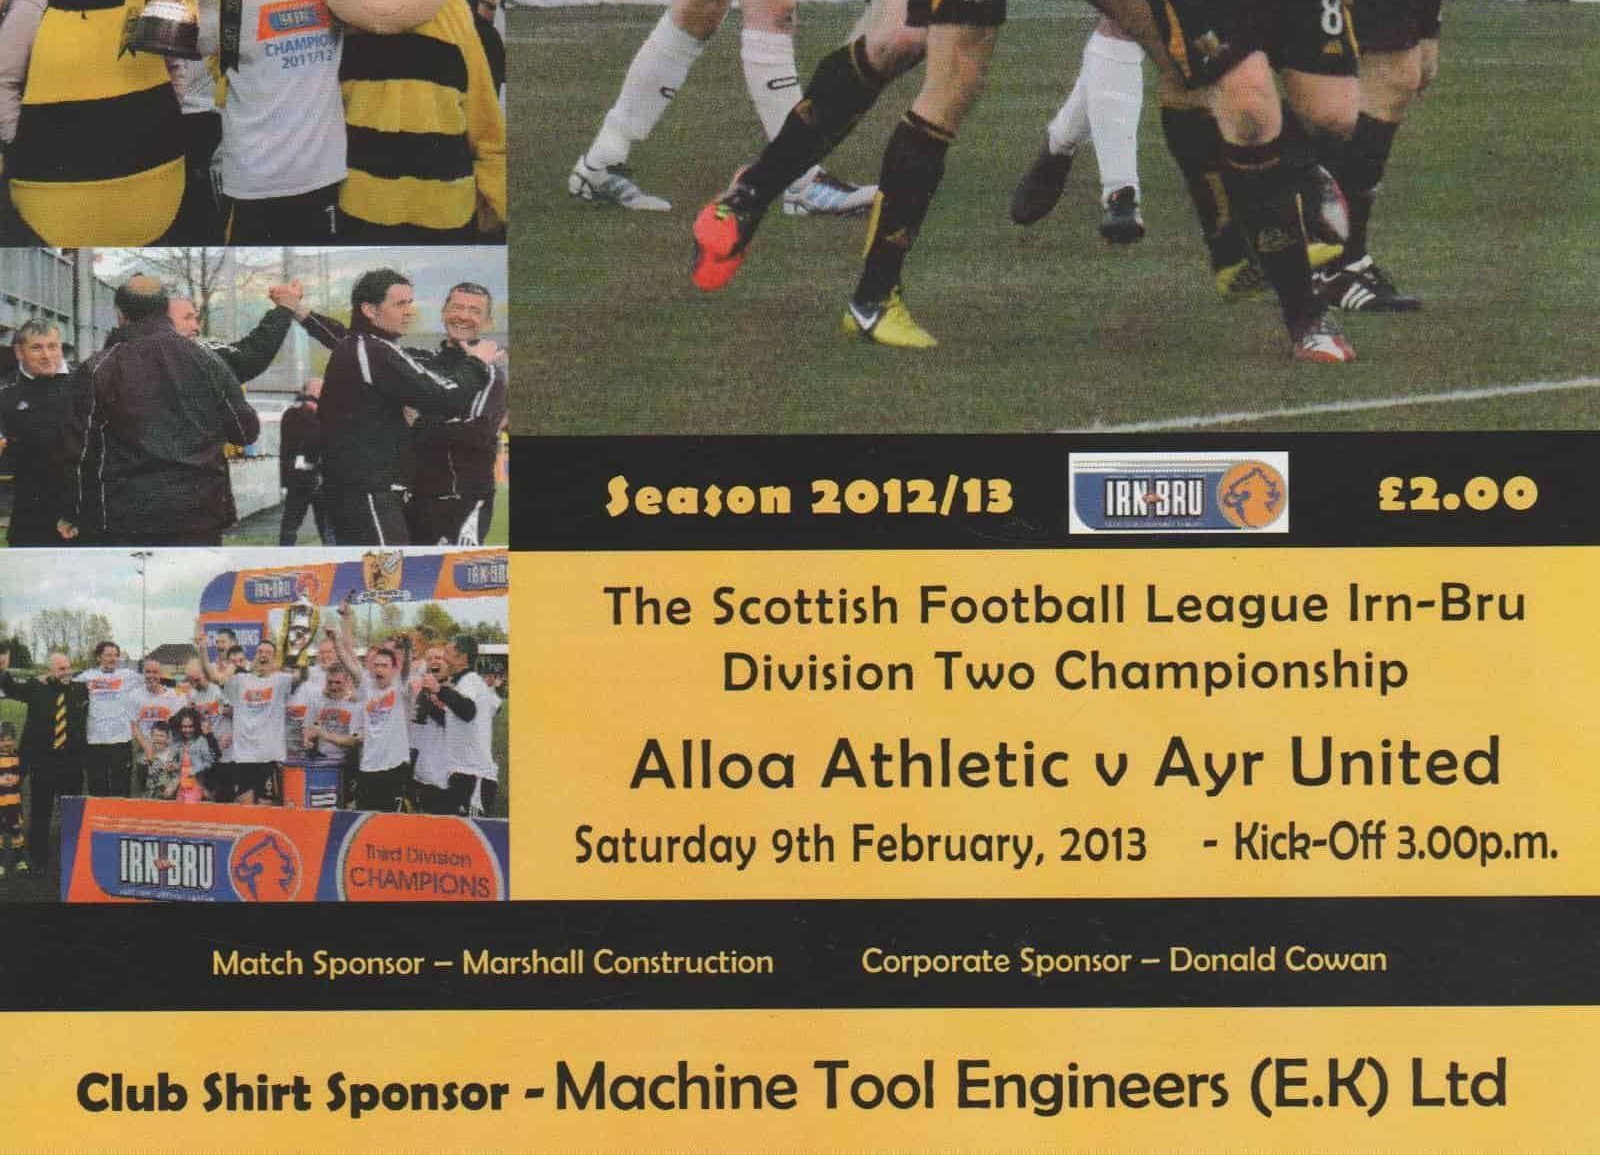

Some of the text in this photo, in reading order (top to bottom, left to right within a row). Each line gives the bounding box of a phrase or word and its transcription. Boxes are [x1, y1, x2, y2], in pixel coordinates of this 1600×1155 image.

[606, 475, 1013, 517] Season 2012/13
[1379, 476, 1537, 510] £2.00
[604, 583, 1524, 628] The Scottish Football League Irn-Bru
[725, 649, 1407, 696] Division Two Championship
[630, 735, 1499, 797] Alloa Athletic v Ayr United
[366, 843, 472, 868] Third Division
[576, 825, 756, 870] Saturday
[773, 824, 833, 863] 9th
[854, 823, 1043, 869] February,
[1061, 828, 1146, 861] 2013
[1236, 820, 1386, 860] Kick-Off
[1398, 826, 1557, 867] 3.00p.m.
[350, 866, 490, 898] CHAMPIONS
[214, 950, 302, 975] Match
[314, 950, 424, 979] Sponsor
[464, 949, 583, 974] Marshall
[594, 949, 773, 974] Construction
[863, 948, 1009, 977] Corporate
[1021, 948, 1132, 977] Sponsor
[1171, 947, 1275, 971] Donald
[1286, 946, 1386, 971] Cowan
[77, 1073, 187, 1112] Club
[203, 1072, 311, 1112] Shirt
[327, 1072, 509, 1118] Sponsor
[557, 1061, 797, 1110] Machine
[814, 1060, 933, 1109] Tool
[958, 1060, 1228, 1117] Engineers
[1251, 1057, 1388, 1117] (E.K)
[1413, 1057, 1506, 1106] Ltd
